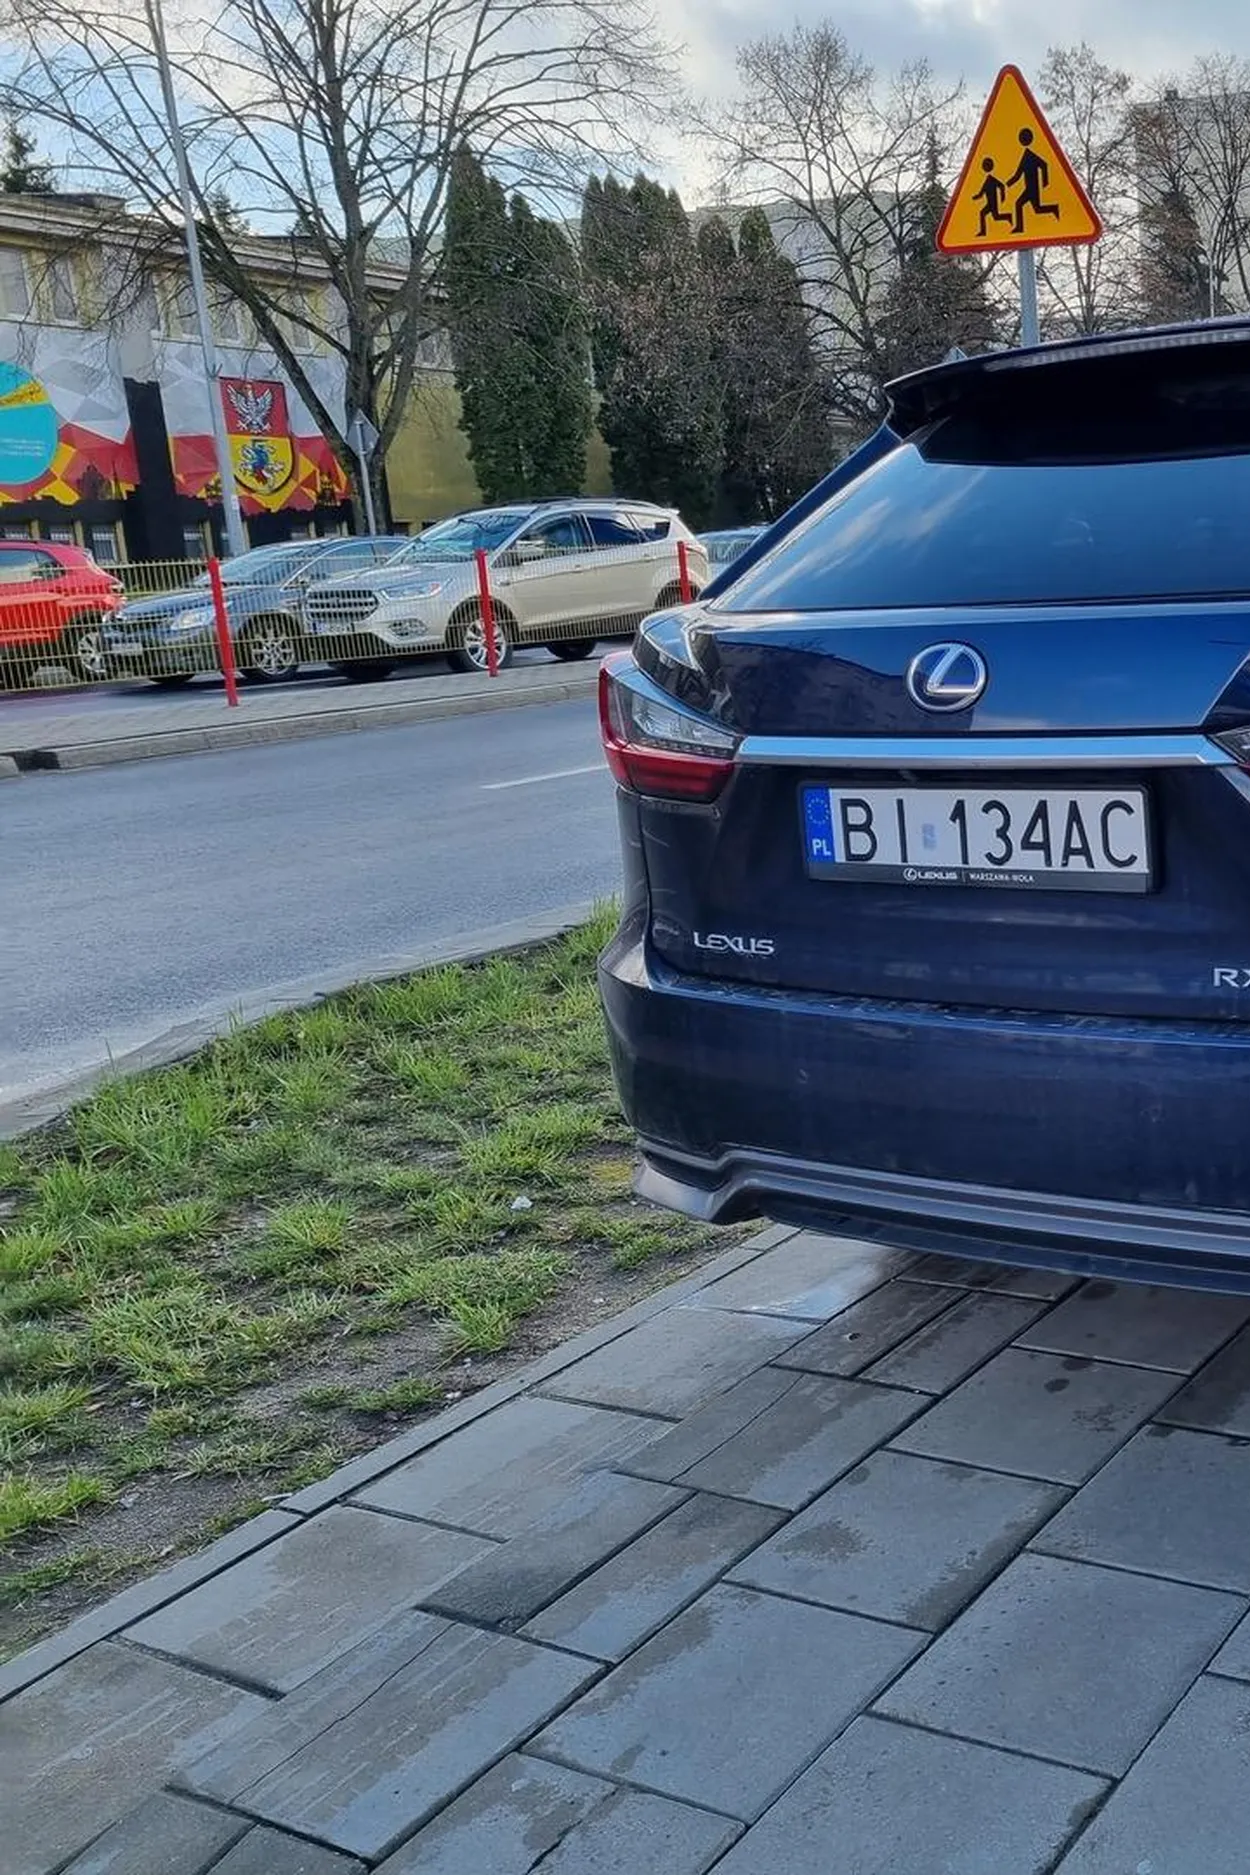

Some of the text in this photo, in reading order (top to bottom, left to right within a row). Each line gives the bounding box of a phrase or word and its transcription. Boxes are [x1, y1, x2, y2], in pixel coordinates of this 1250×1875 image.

[839, 797, 1138, 869] BI 134AC
[812, 838, 832, 857] PL
[917, 871, 958, 881] LEXUS
[693, 931, 775, 955] LEXUS
